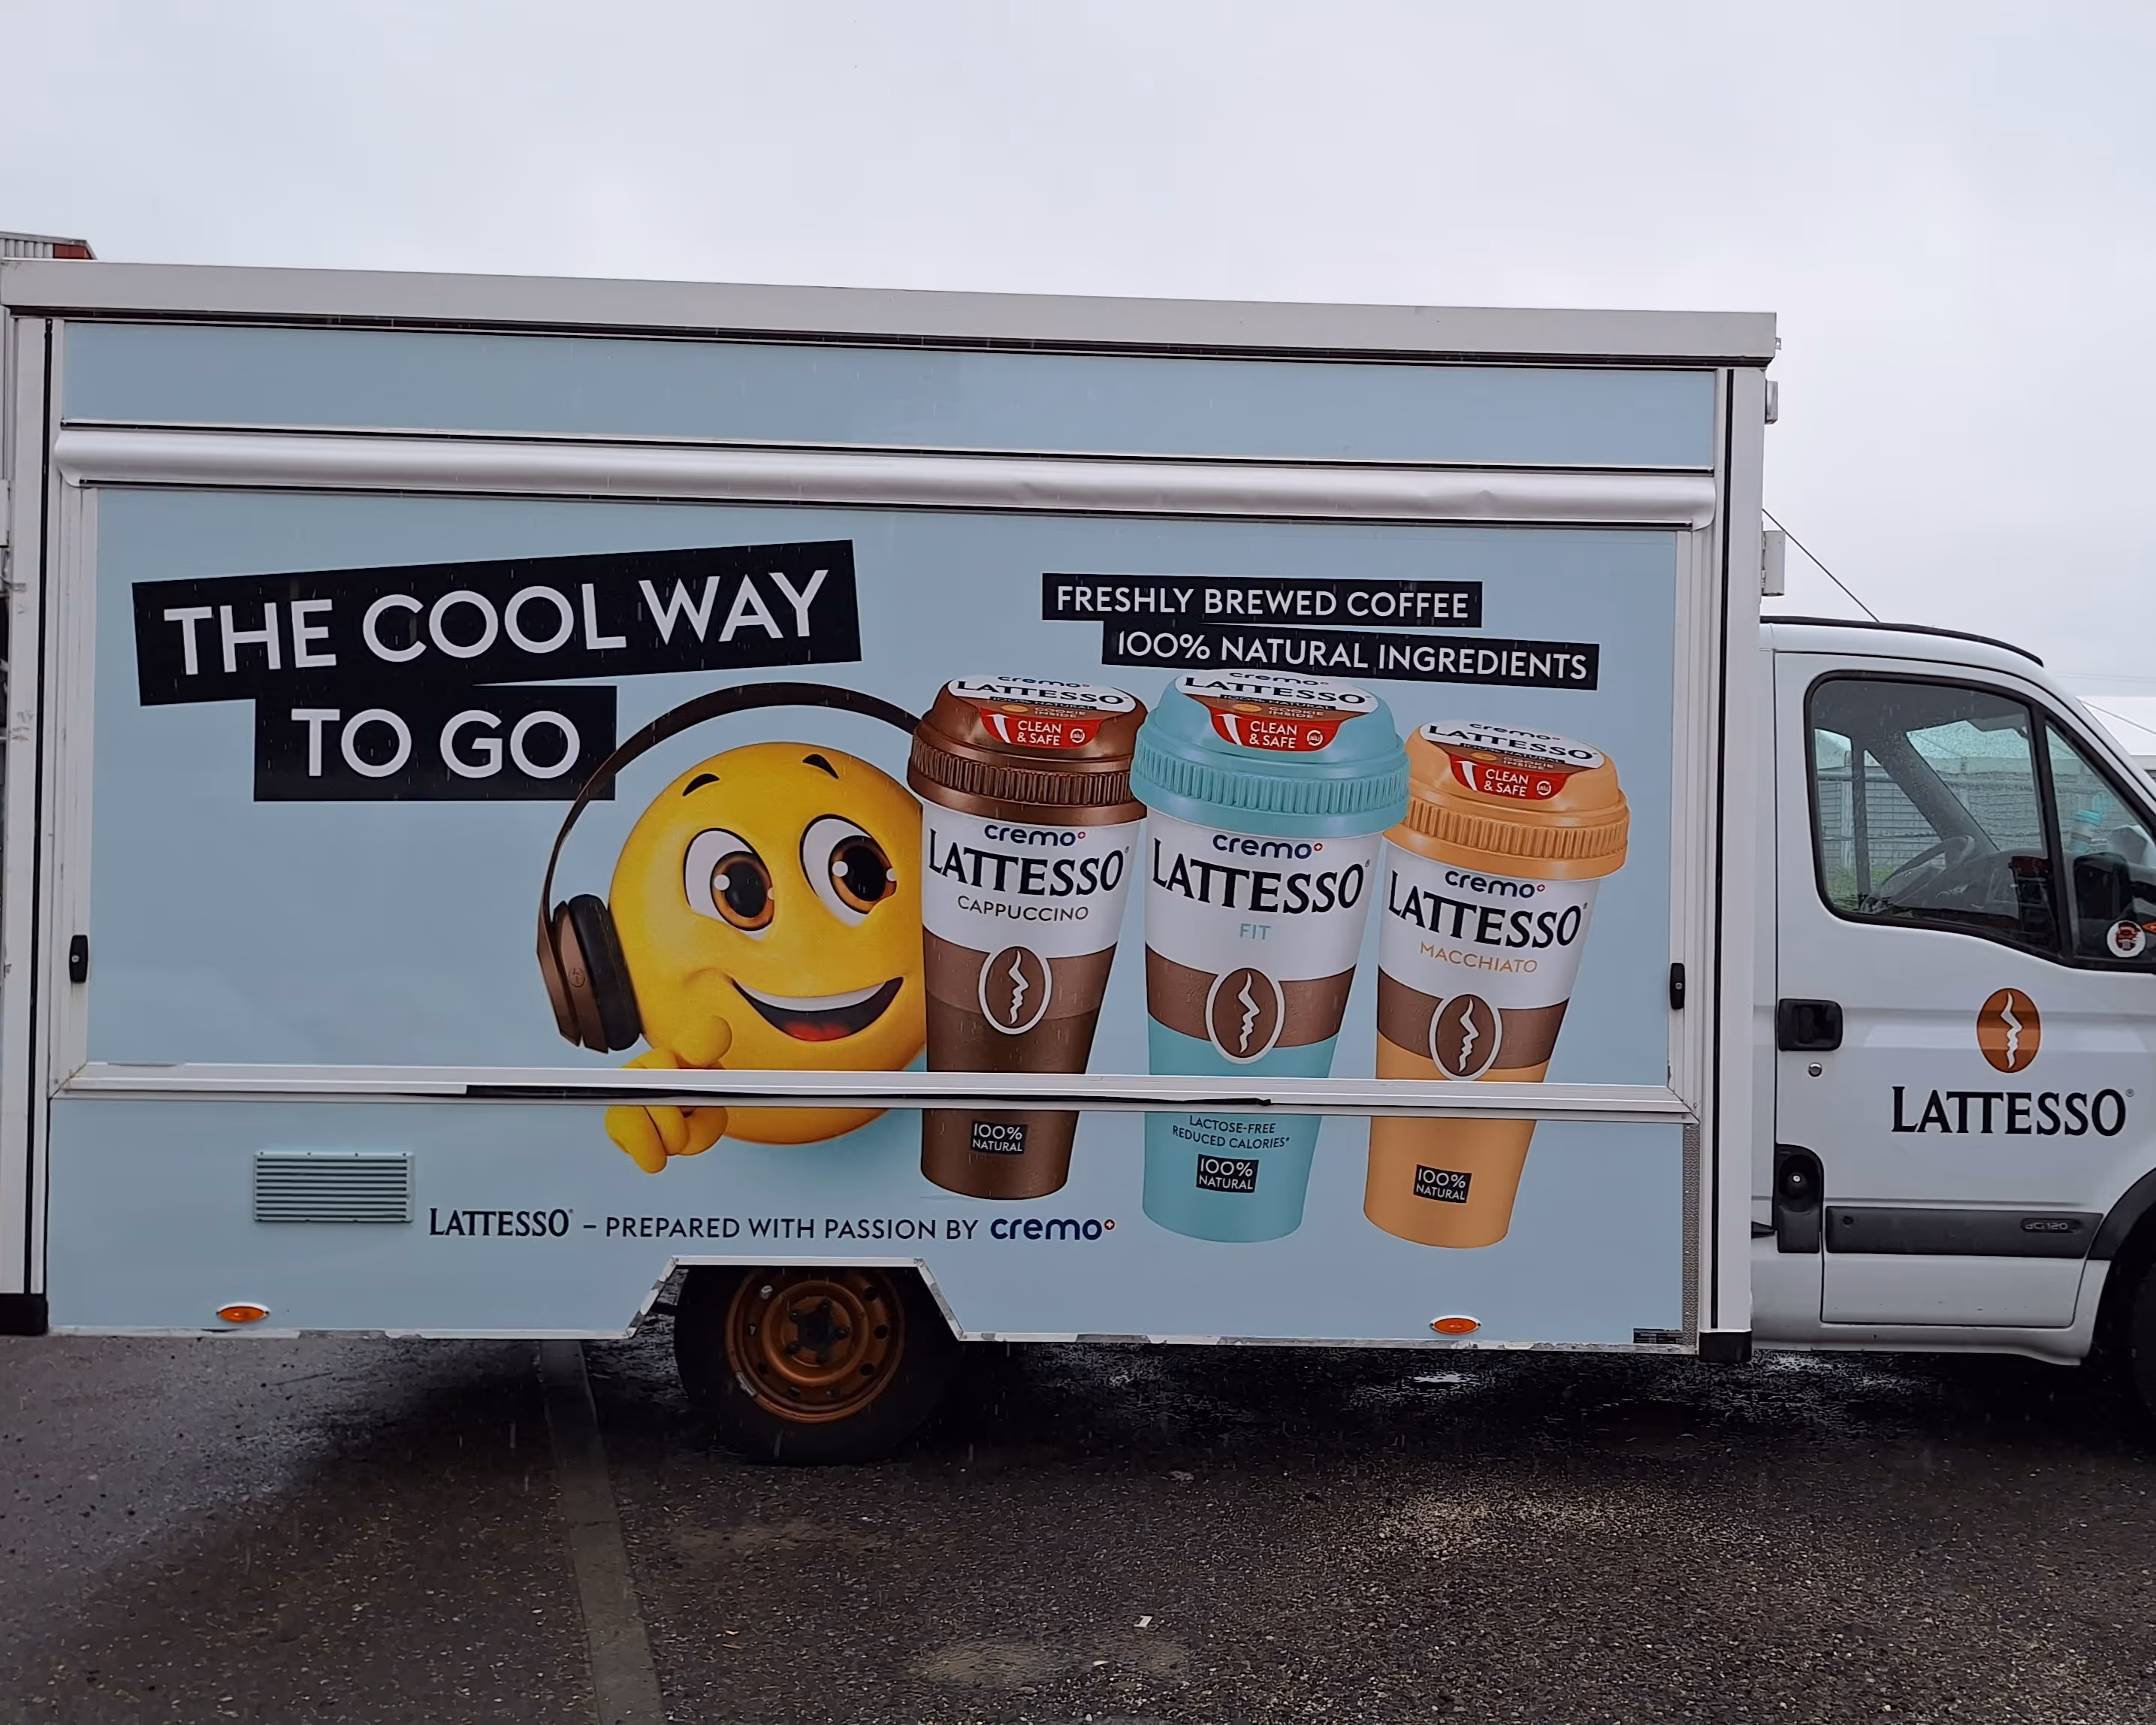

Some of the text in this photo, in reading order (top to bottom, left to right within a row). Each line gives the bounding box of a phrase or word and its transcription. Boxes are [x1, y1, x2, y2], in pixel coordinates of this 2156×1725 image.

[1057, 586, 1468, 618] FRESHLY BREWED COFFEE
[164, 569, 829, 675] THE COOL WAY
[1119, 631, 1587, 679] 100% NATURAL INGREDIENTS
[998, 676, 1082, 687] cremo
[1229, 672, 1318, 685] cremo
[957, 681, 1124, 704] LATTESSO
[1185, 677, 1366, 704] LATTESSO
[1035, 701, 1093, 710] NATURAL
[1269, 706, 1324, 715] COOKIE
[1270, 699, 1333, 710] NATURAL
[1018, 720, 1061, 734] CLEAN
[1250, 721, 1297, 735] CLEAN
[1469, 724, 1551, 740] cremo
[291, 708, 581, 779] TO GO
[1017, 732, 1060, 745] & SAFE
[1249, 733, 1296, 748] & SAFE
[1429, 725, 1593, 760] LATTESSO
[1504, 751, 1563, 763] NATURAL
[1504, 757, 1554, 769] COOKIE
[1504, 760, 1545, 770] INSIDE
[1485, 769, 1529, 784] CLEAN
[1484, 781, 1526, 796] & SAFE
[984, 825, 1076, 846] cremo
[1212, 835, 1312, 859] cremo
[929, 829, 1124, 896] LATTESSO
[1153, 838, 1363, 914] LATTESSO
[1445, 871, 1535, 898] cremo
[958, 896, 1089, 921] CAPPUCCINO
[1388, 870, 1581, 948] LATTESSO
[1240, 923, 1270, 940] FIT
[1420, 941, 1538, 973] MACCHIATO
[1891, 1086, 2126, 1136] LATTESSO
[974, 1123, 1022, 1140] 100%
[1190, 1115, 1276, 1134] LACTOSE-FREE
[972, 1139, 1022, 1151] NATURAL
[1173, 1125, 1226, 1146] REDUCED
[1200, 1158, 1253, 1177] 100%
[1199, 1174, 1253, 1189] NATURAL
[1418, 1168, 1466, 1188] 100%
[1416, 1183, 1465, 1200] NATURAL
[430, 1207, 569, 1237] LATTESSO
[606, 1216, 740, 1238] PREPARED
[749, 1218, 814, 1239] WITH
[826, 1219, 936, 1240] PASSION
[947, 1220, 979, 1240] BY
[991, 1218, 1103, 1240] cremo
